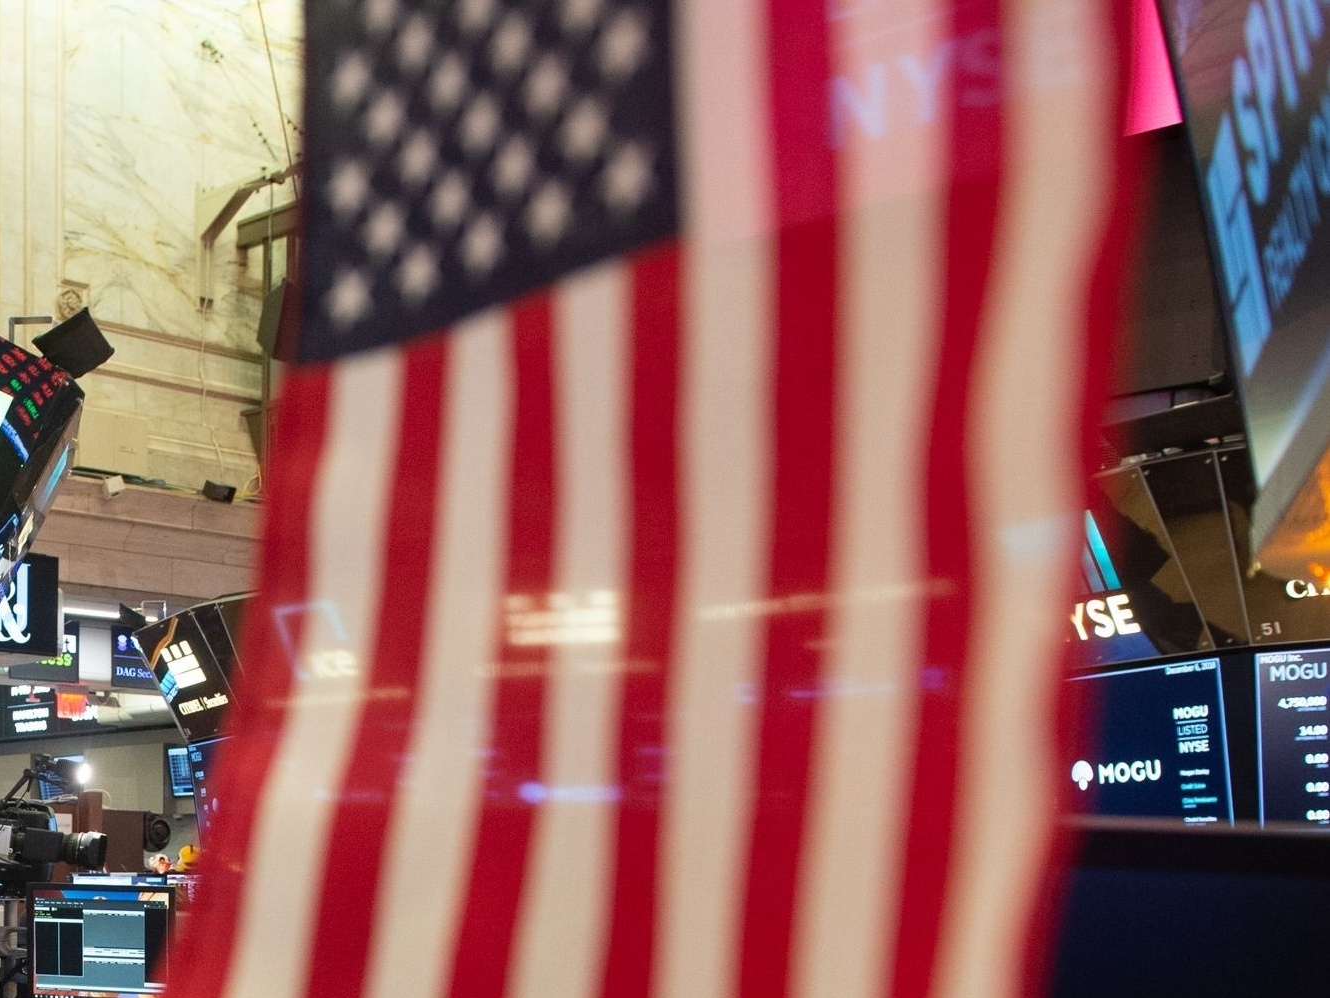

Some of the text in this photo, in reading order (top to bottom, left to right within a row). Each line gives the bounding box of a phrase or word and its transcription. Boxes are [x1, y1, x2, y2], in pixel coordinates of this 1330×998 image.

[1070, 594, 1141, 641] YSE
[116, 666, 136, 677] DAG
[1270, 662, 1327, 681] MOGU
[1173, 705, 1209, 720] MOGU
[1177, 723, 1208, 736] LISTED
[1178, 739, 1210, 754] NYSE
[1098, 759, 1161, 785] MOGU
